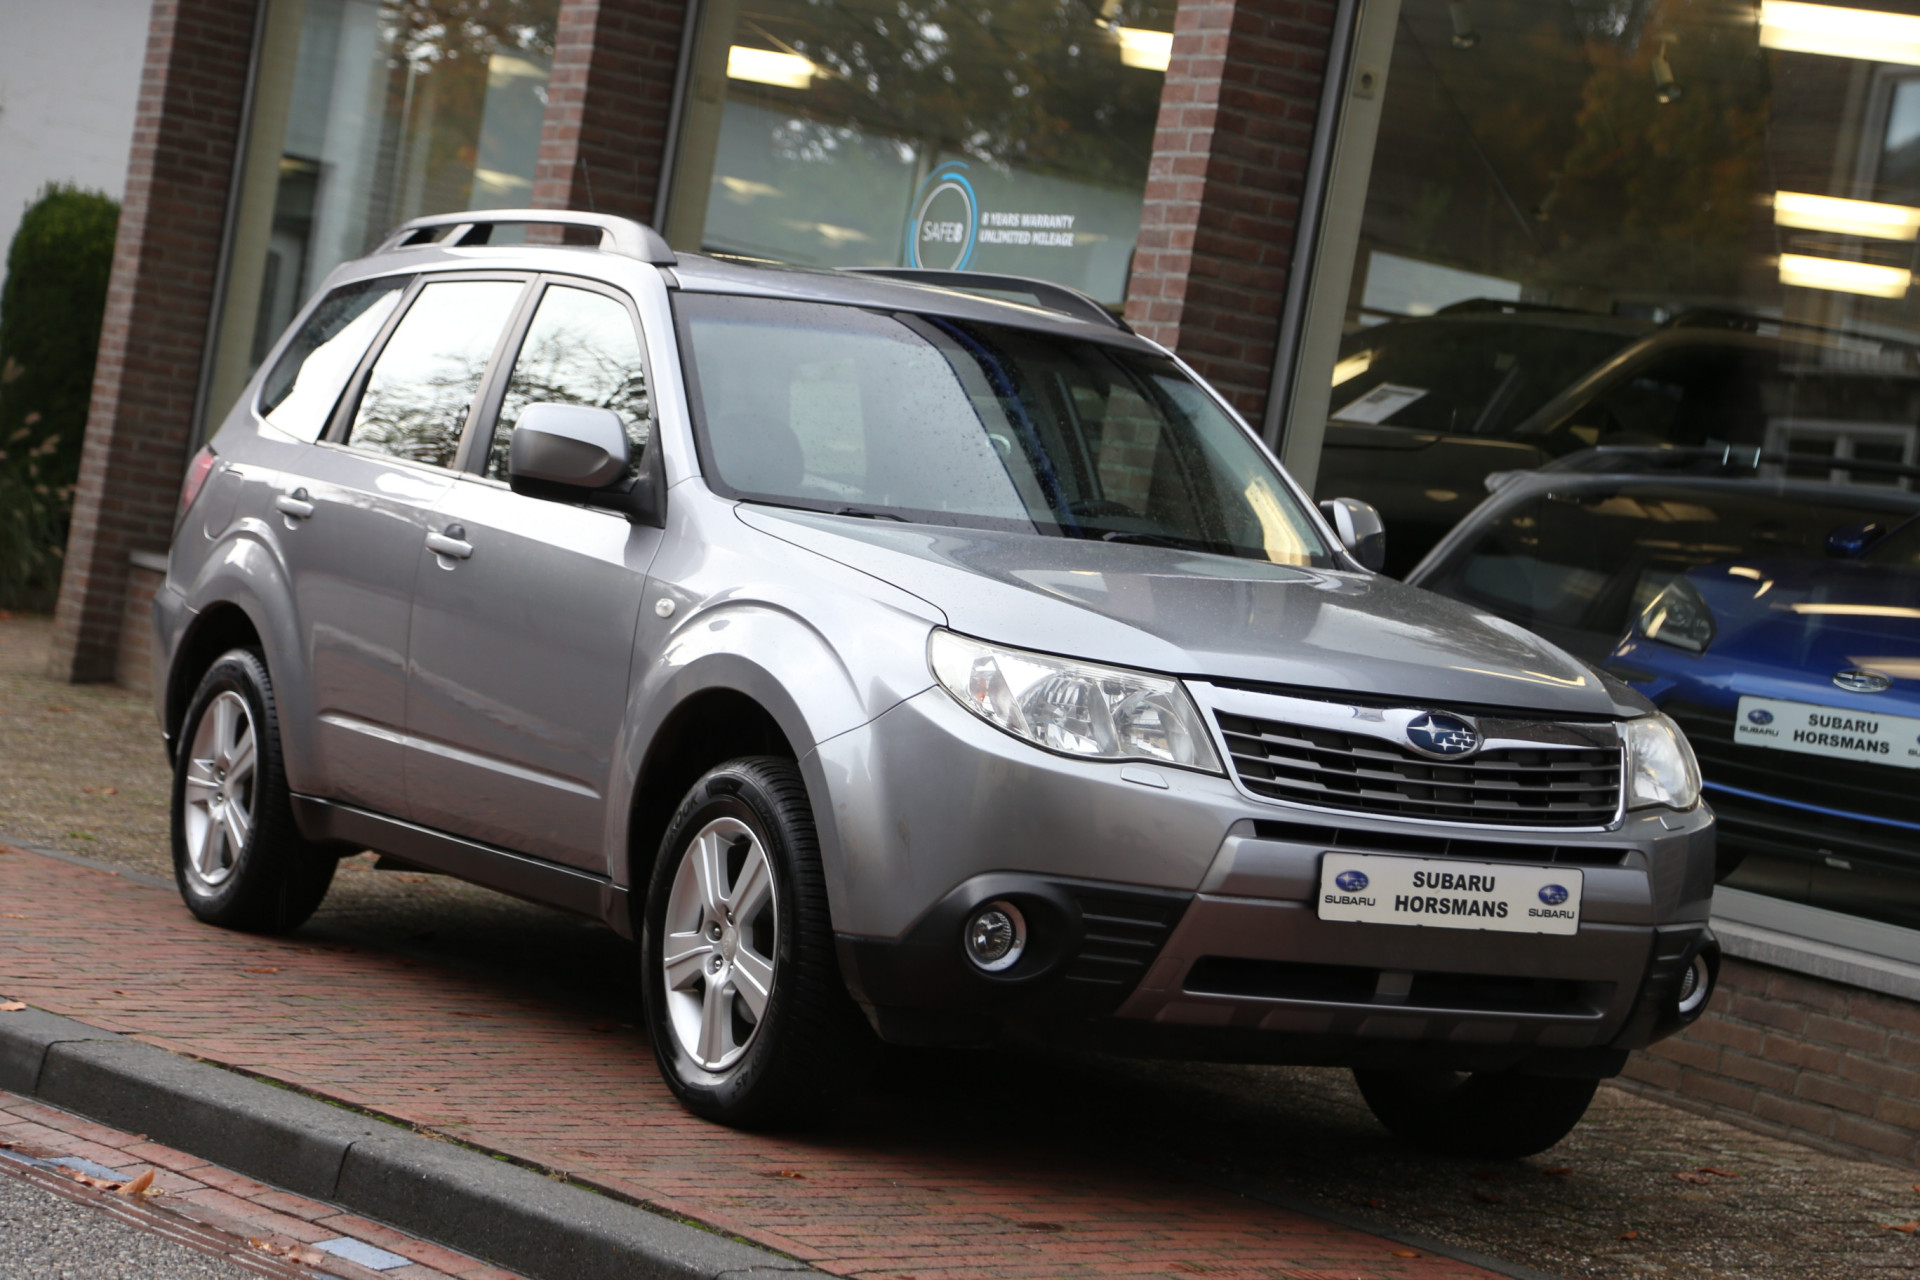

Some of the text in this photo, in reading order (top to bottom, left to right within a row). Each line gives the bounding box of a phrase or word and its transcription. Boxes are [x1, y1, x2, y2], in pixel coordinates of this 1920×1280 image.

[981, 211, 1075, 229] 8 YEARS WARRANTY
[921, 220, 964, 244] SAFE8
[979, 228, 1074, 247] UNLIMITED MILEAGE
[1739, 725, 1779, 737] SUBARU
[1808, 713, 1879, 734] SUBARU
[1793, 729, 1890, 755] HORSMANS
[1413, 871, 1496, 893] SUBARU
[1324, 895, 1376, 907] SUBARU
[1394, 895, 1509, 919] HORSMANS
[1528, 908, 1575, 920] SUBARU
